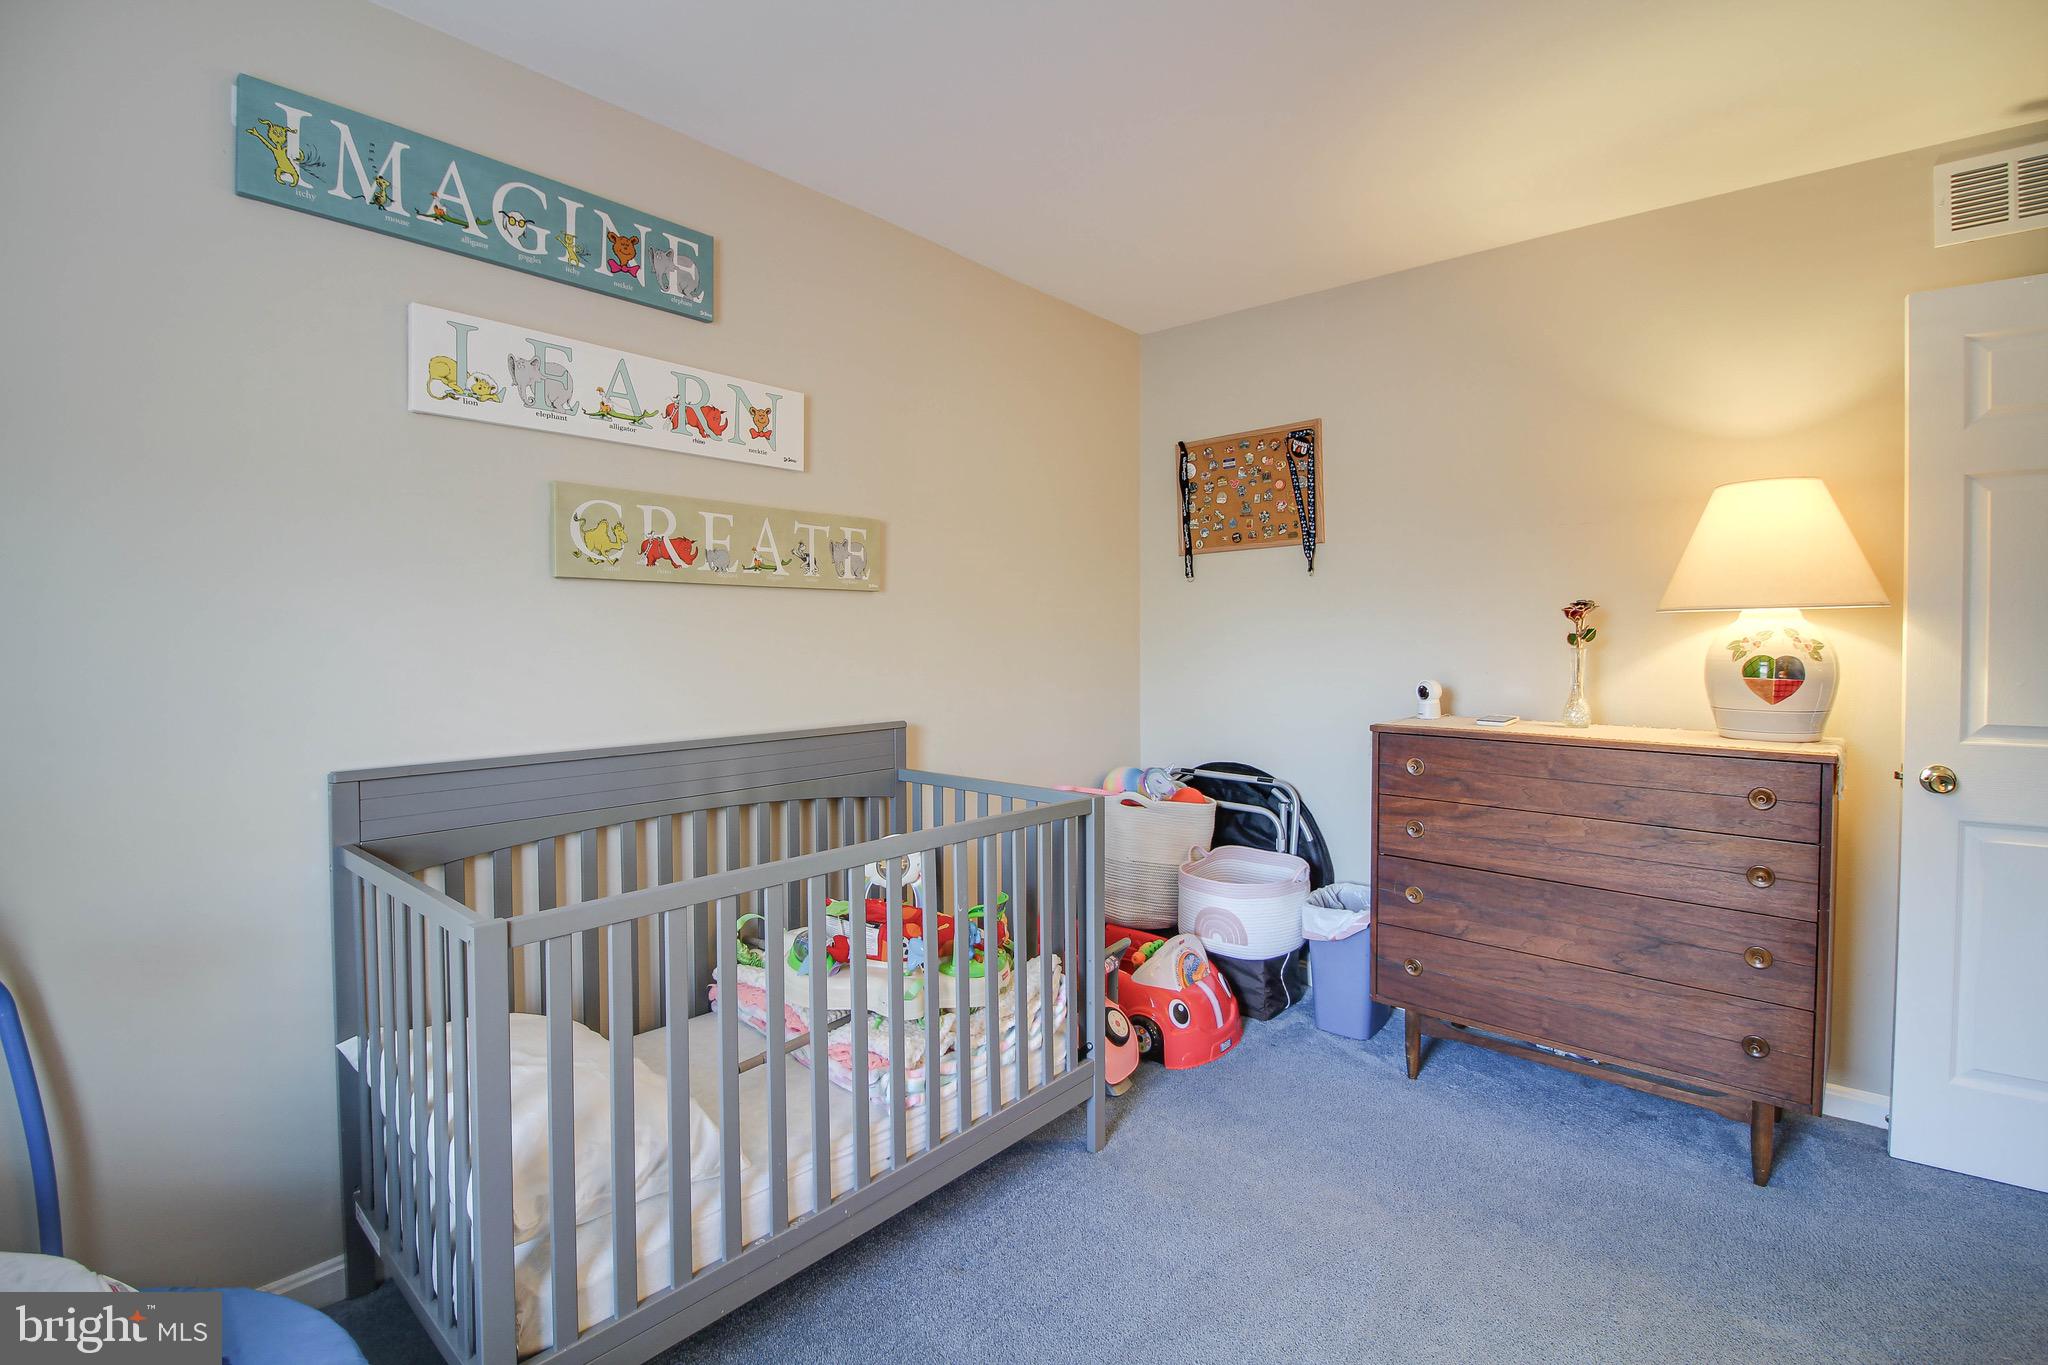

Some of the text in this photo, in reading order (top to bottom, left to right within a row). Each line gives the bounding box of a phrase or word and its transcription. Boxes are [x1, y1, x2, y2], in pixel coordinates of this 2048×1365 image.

[295, 188, 317, 202] itchy
[274, 102, 705, 304] IMAGINE
[446, 320, 784, 452] LEARN
[462, 398, 479, 407] lion
[535, 411, 568, 422] elephant
[608, 423, 638, 434] alligator
[692, 437, 706, 446] rhino
[569, 499, 871, 580] CREATE
